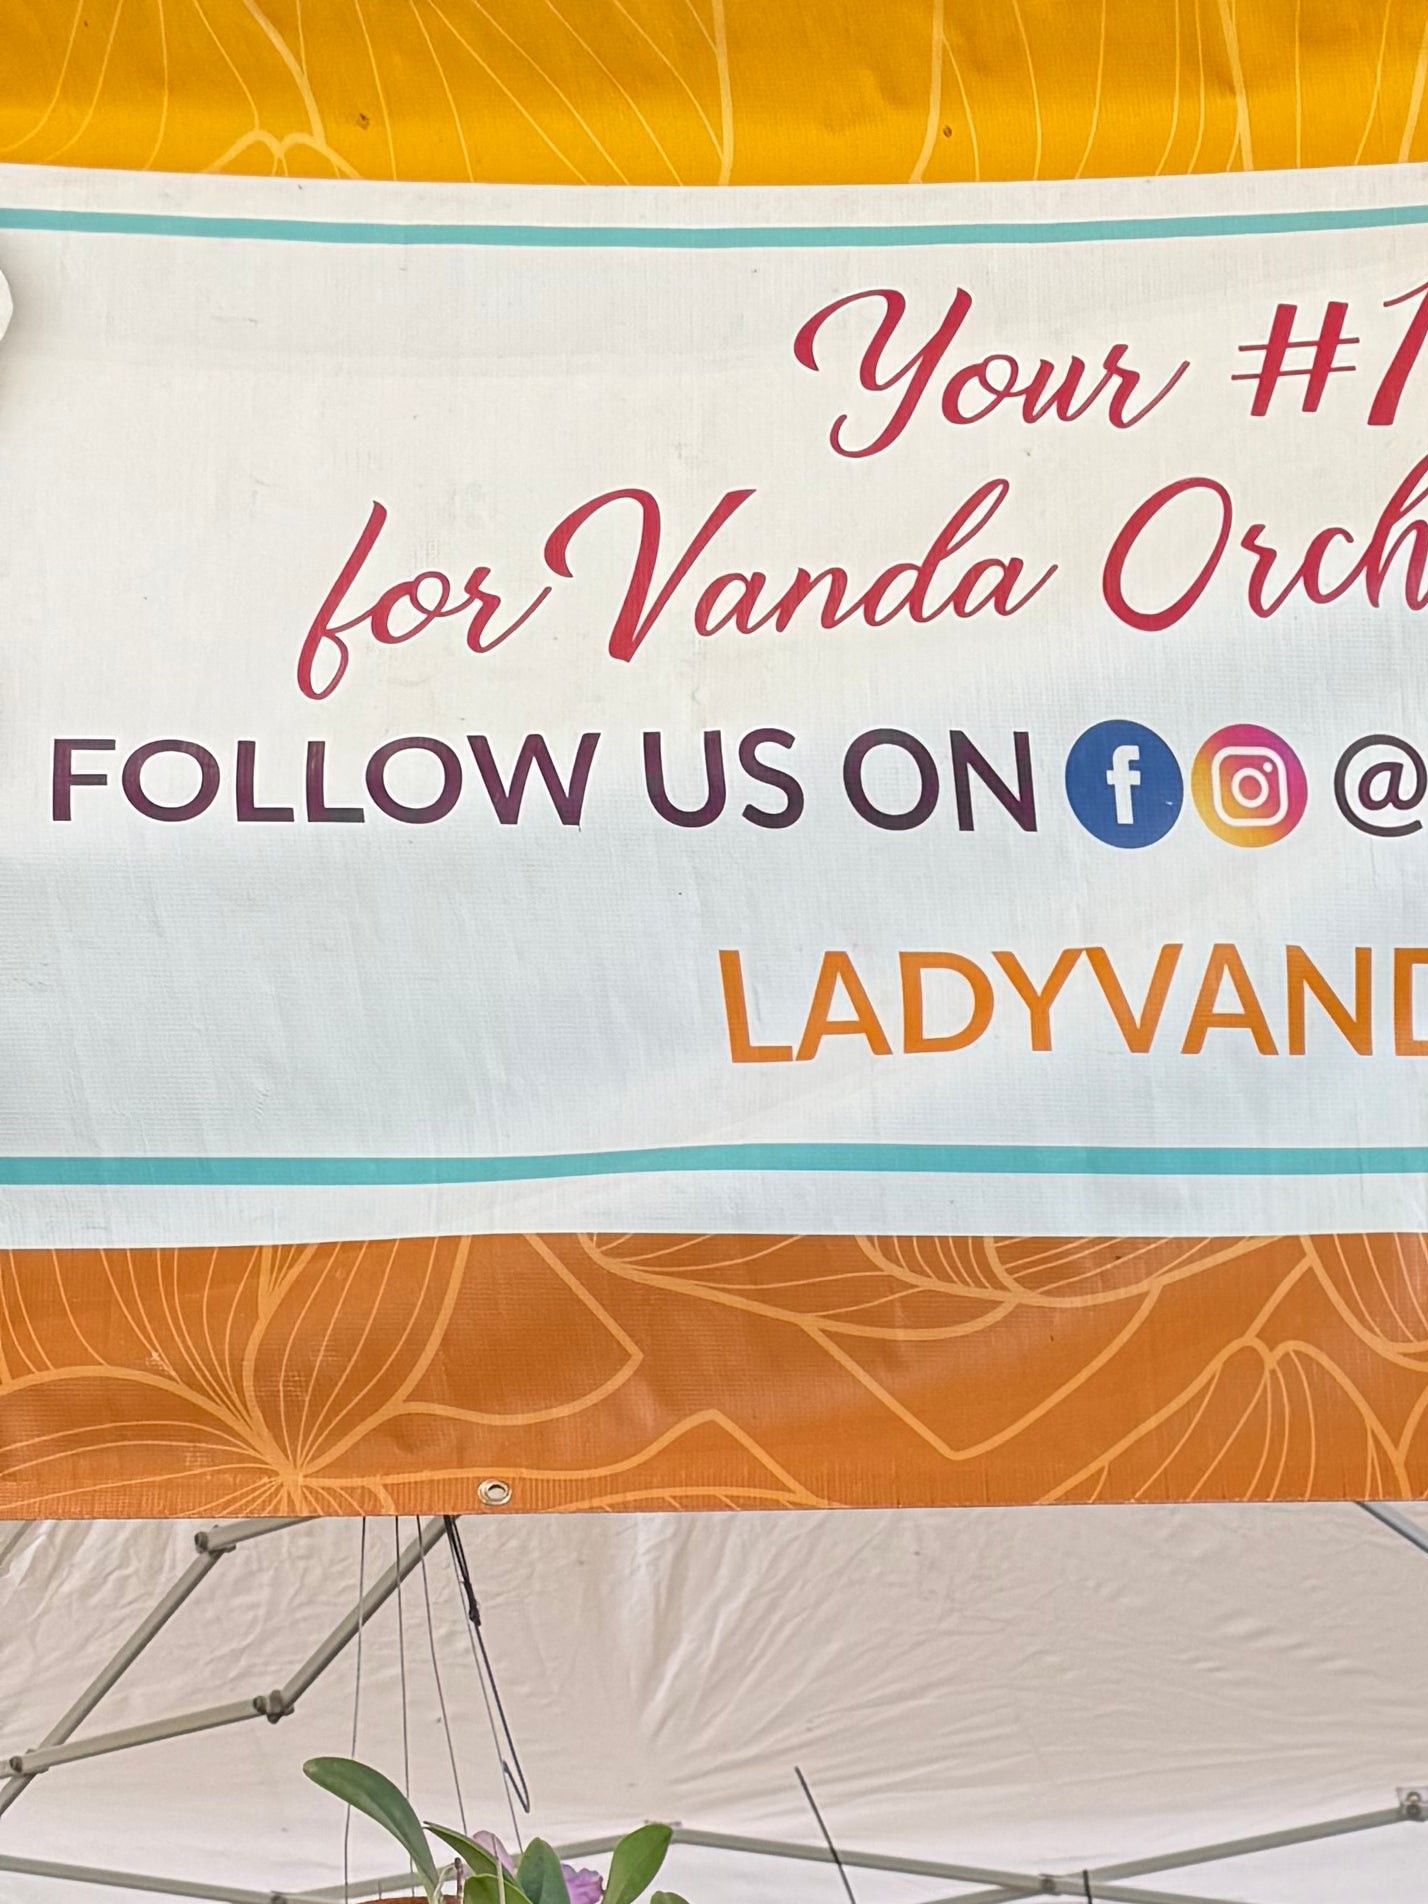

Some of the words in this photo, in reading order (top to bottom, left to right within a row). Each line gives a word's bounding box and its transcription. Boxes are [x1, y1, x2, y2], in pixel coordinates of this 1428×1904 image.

[793, 287, 1191, 459] Your
[296, 500, 553, 701] for
[543, 478, 1059, 663] Vanda
[52, 732, 602, 827] FOLLOW
[642, 727, 805, 830] US
[842, 728, 1038, 833] ON
